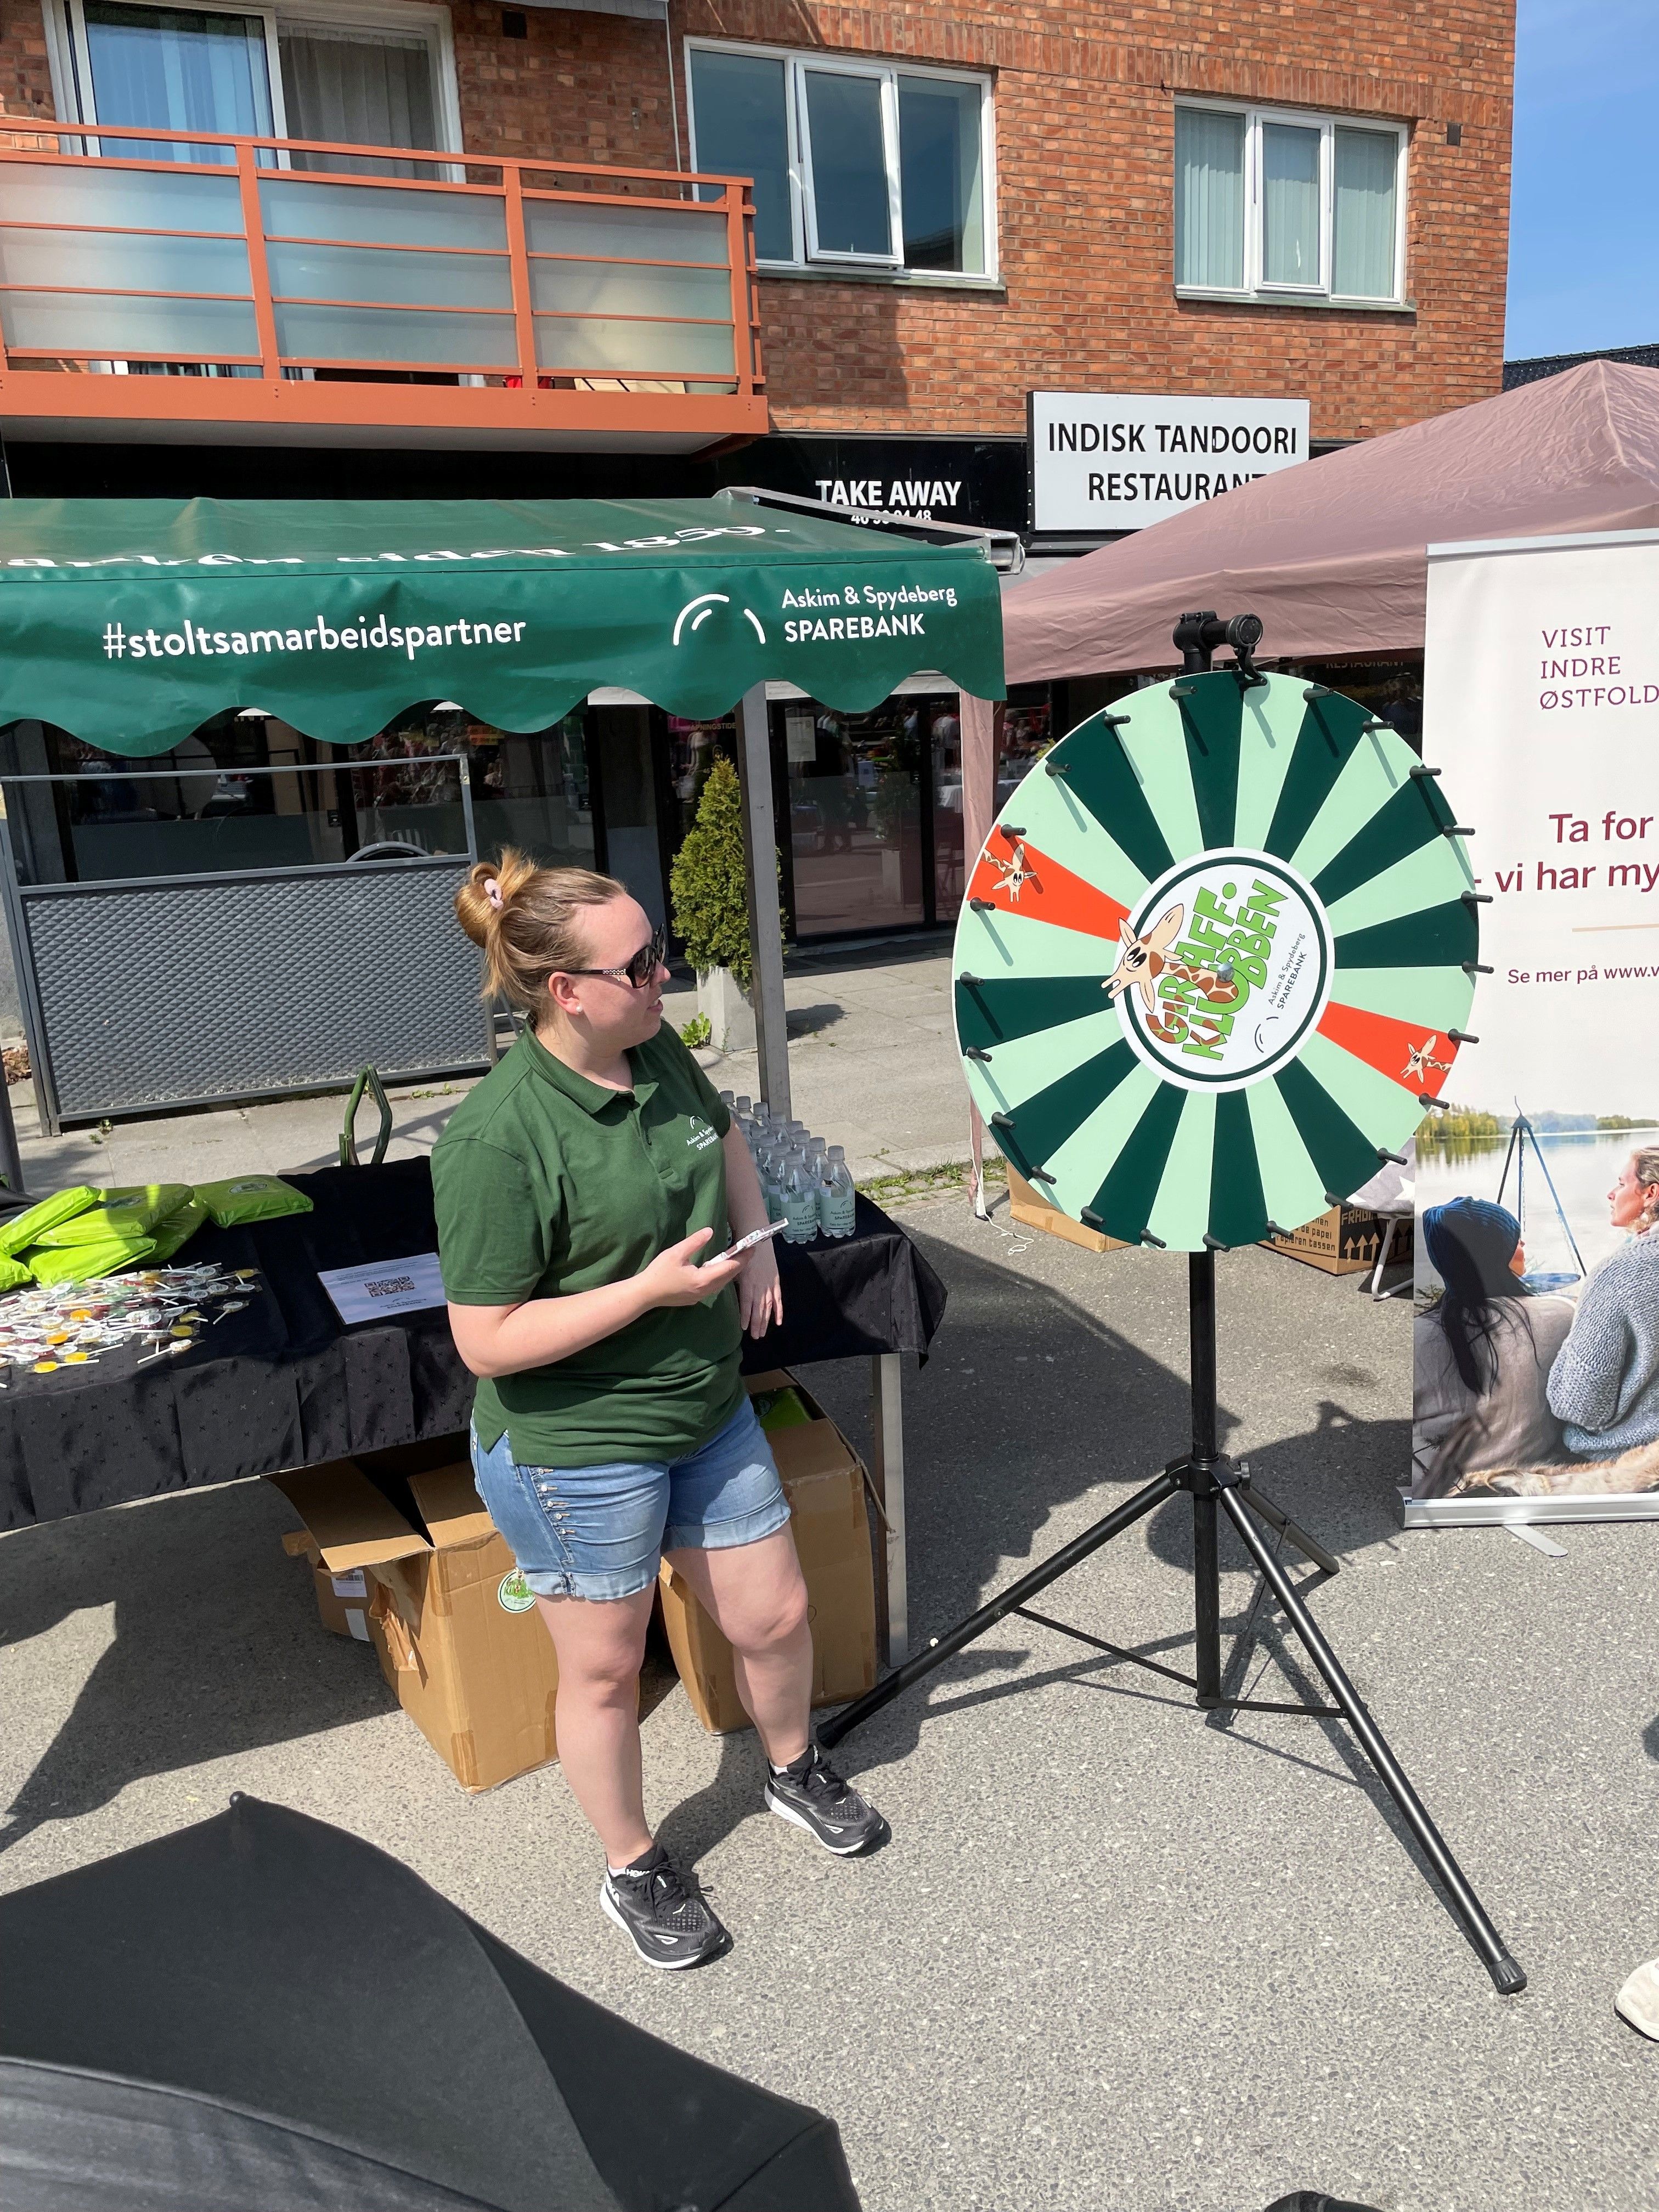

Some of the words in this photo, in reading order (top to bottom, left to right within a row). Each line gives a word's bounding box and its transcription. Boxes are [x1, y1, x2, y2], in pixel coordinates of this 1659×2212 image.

[1049, 423, 1146, 452] INDISK
[1155, 425, 1296, 454] TANDOORI
[815, 480, 883, 506] TAKE
[888, 481, 962, 506] AWAY
[1088, 473, 1267, 501] RESTAURAN
[582, 525, 791, 552] 1859.
[782, 588, 840, 608] Askim
[844, 586, 860, 605] &
[863, 585, 958, 611] Spydeberg
[103, 614, 527, 660] #stoltsamarbeidspartner
[784, 613, 926, 642] SPAREBANK
[1542, 626, 1611, 648] VISIT
[1541, 656, 1621, 679] INDRE
[1539, 685, 1659, 710] ØSTFOLD
[1549, 813, 1589, 844] Ta
[1601, 810, 1654, 840] for
[1494, 862, 1523, 892] vi
[1537, 861, 1596, 890] har
[1268, 981, 1283, 1006] Askim
[1282, 933, 1306, 972] Spydeberg
[1277, 951, 1307, 1009] SPAREBANK
[1508, 969, 1530, 984] Se
[1536, 970, 1571, 983] mer
[1577, 964, 1598, 984] på
[1341, 1209, 1373, 1226] FRAGI
[1309, 1238, 1335, 1251] tassen
[1312, 1228, 1332, 1240] papel
